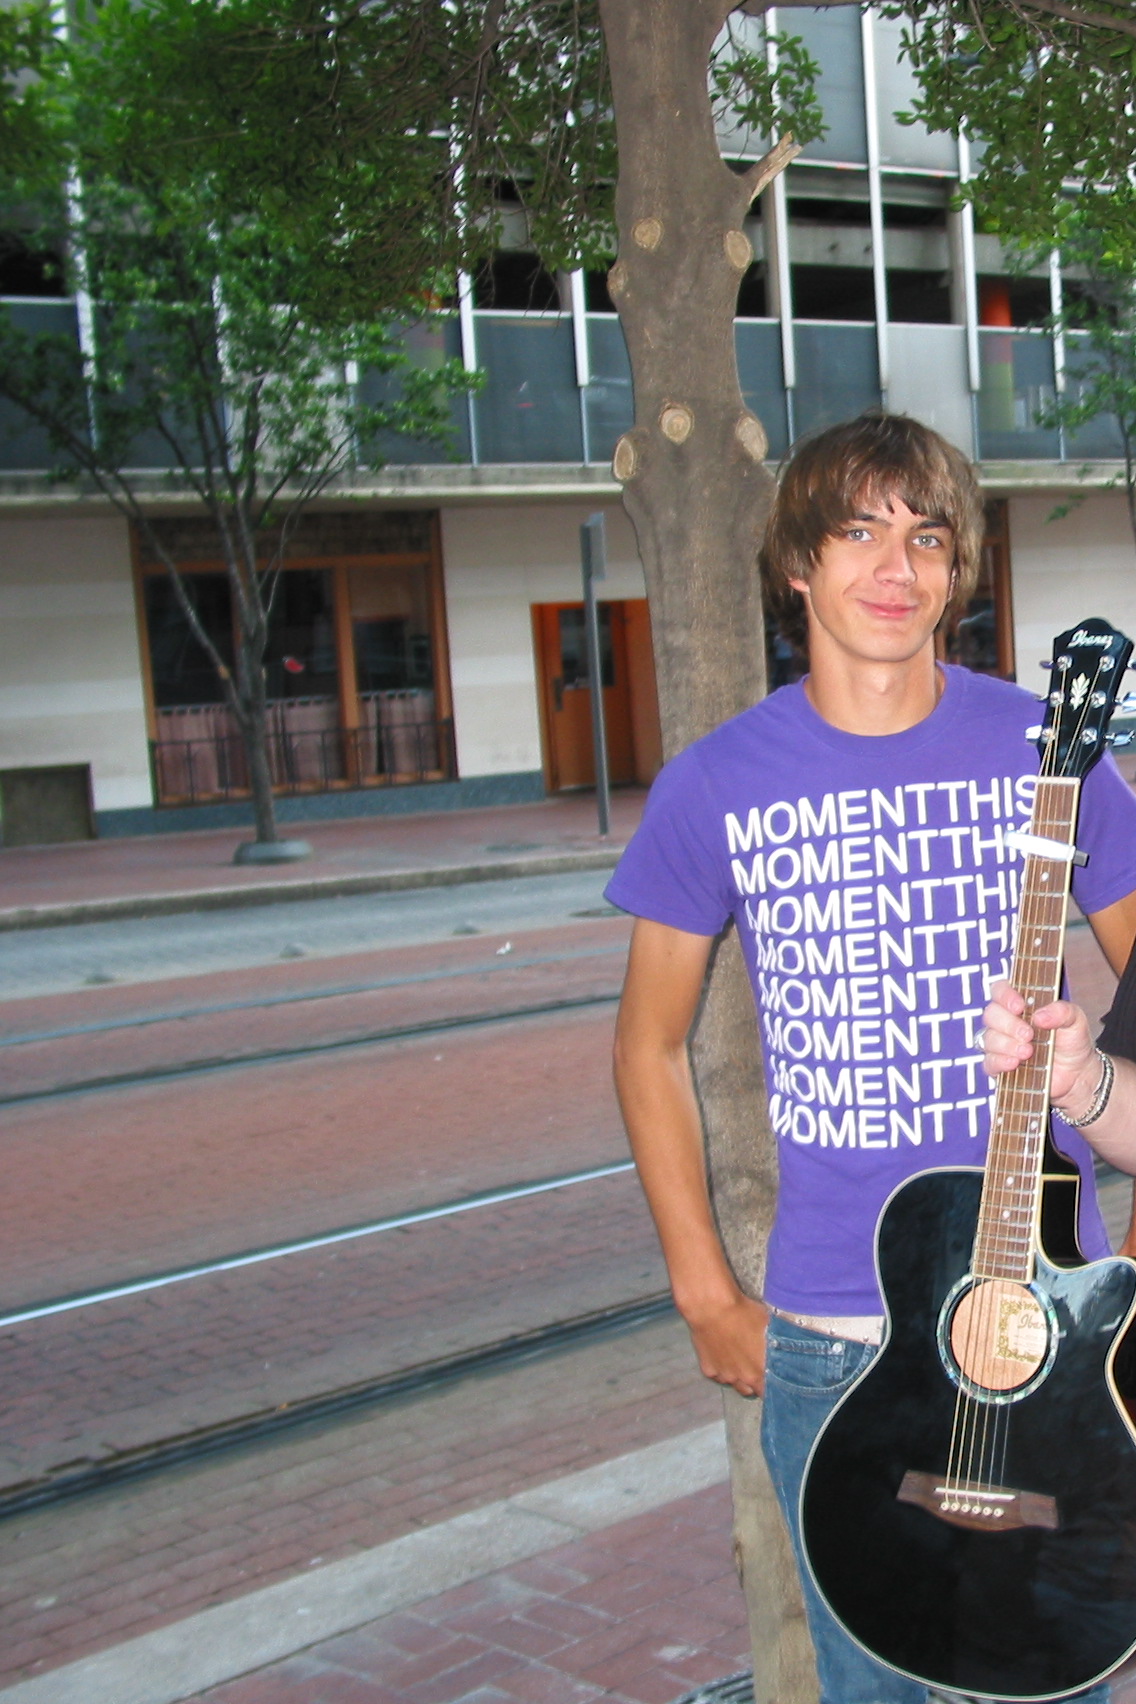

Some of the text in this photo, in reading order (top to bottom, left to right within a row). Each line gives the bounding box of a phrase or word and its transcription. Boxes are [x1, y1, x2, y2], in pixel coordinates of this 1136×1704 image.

[1067, 629, 1113, 650] Ibanez
[724, 774, 1037, 853] MOMENTTHIS
[745, 868, 1026, 937] MOMENTTHI
[769, 1054, 996, 1106] MOMENTT
